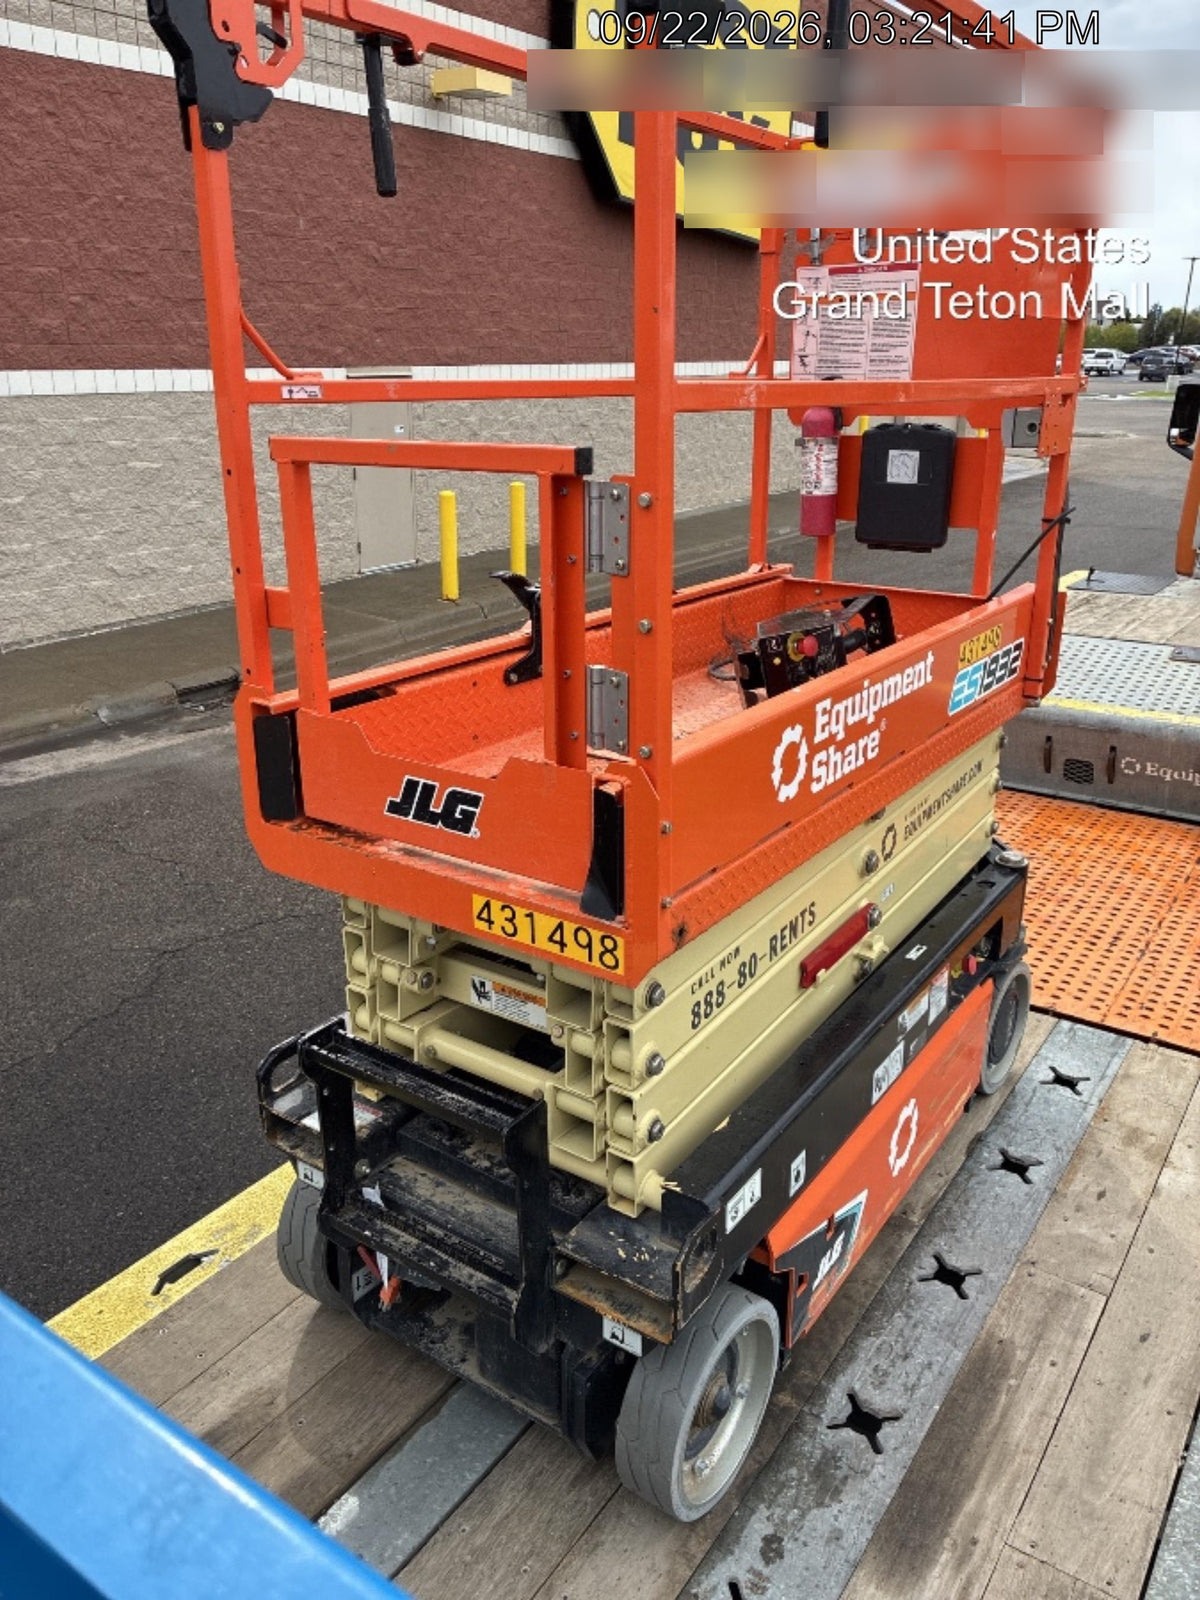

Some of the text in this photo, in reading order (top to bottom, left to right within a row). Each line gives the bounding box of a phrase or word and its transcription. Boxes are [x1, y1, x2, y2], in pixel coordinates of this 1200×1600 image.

[814, 650, 935, 744] Equipment
[948, 638, 1024, 714] ES1932
[810, 728, 881, 794] Share
[384, 775, 484, 837] JLG
[475, 899, 620, 971] 431498
[690, 900, 817, 1021] 888-80-RENTS
